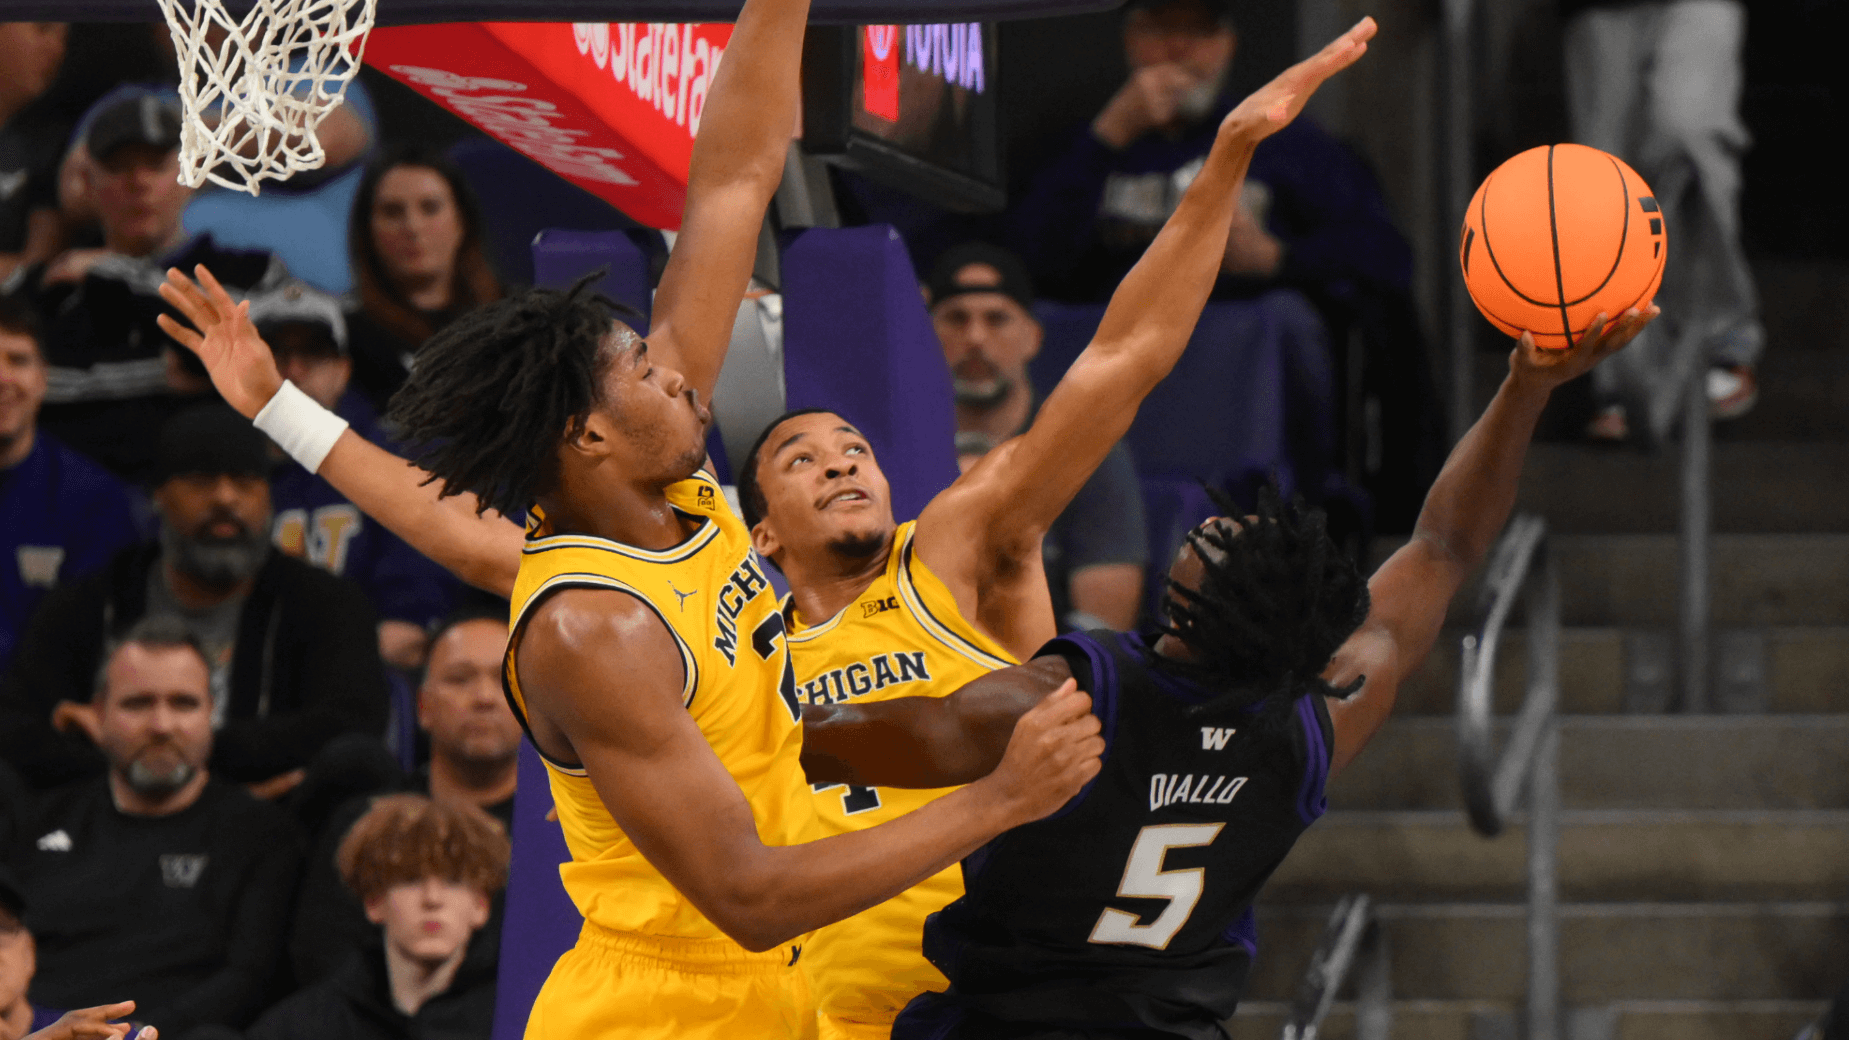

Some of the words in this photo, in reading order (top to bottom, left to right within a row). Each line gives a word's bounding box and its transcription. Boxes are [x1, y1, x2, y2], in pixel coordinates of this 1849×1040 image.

[713, 546, 768, 669] MICH
[796, 650, 932, 705] HIGAN
[1201, 726, 1237, 751] W
[1150, 773, 1249, 812] DIALLO
[1087, 822, 1228, 951] 5
